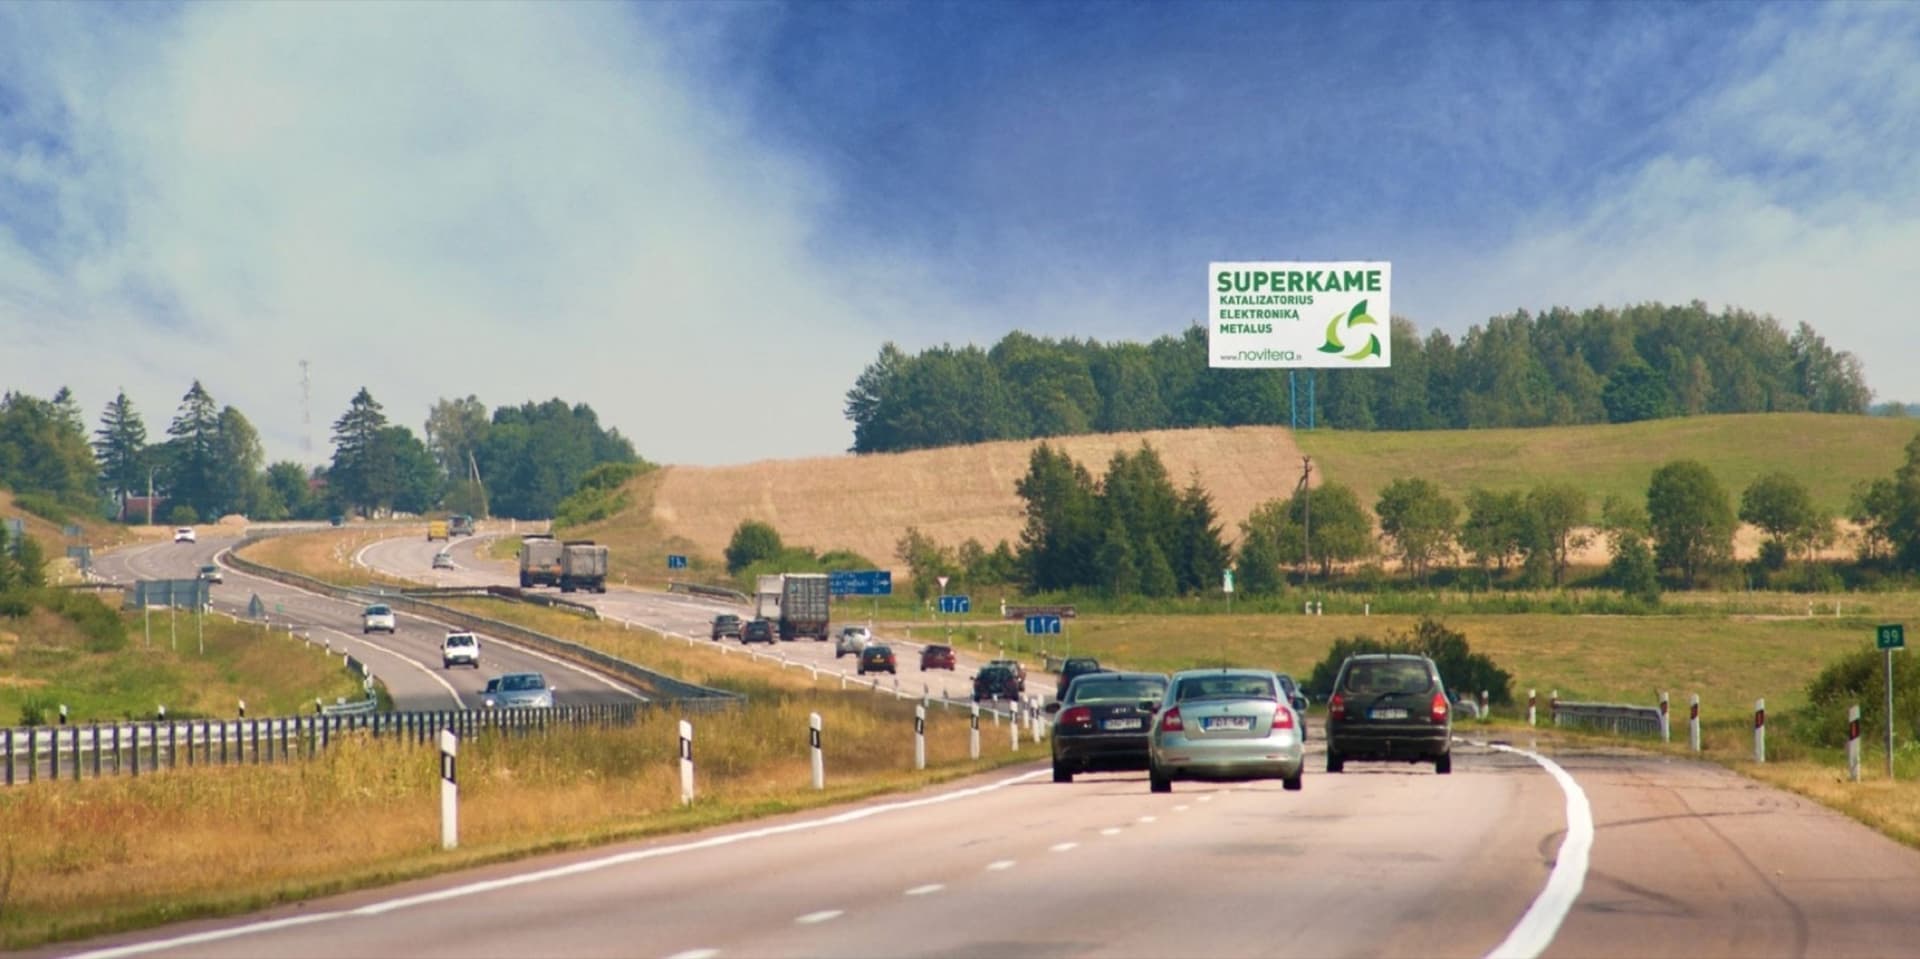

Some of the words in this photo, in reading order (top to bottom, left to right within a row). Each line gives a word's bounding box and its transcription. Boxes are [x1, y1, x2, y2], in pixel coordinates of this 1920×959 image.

[1217, 271, 1382, 292] SUPERKAME
[1219, 295, 1314, 306] KATALIZATORIUS
[1219, 309, 1300, 321] ELEKTRONIKĄ
[1219, 323, 1273, 334] METALUS
[1882, 629, 1899, 644] 99
